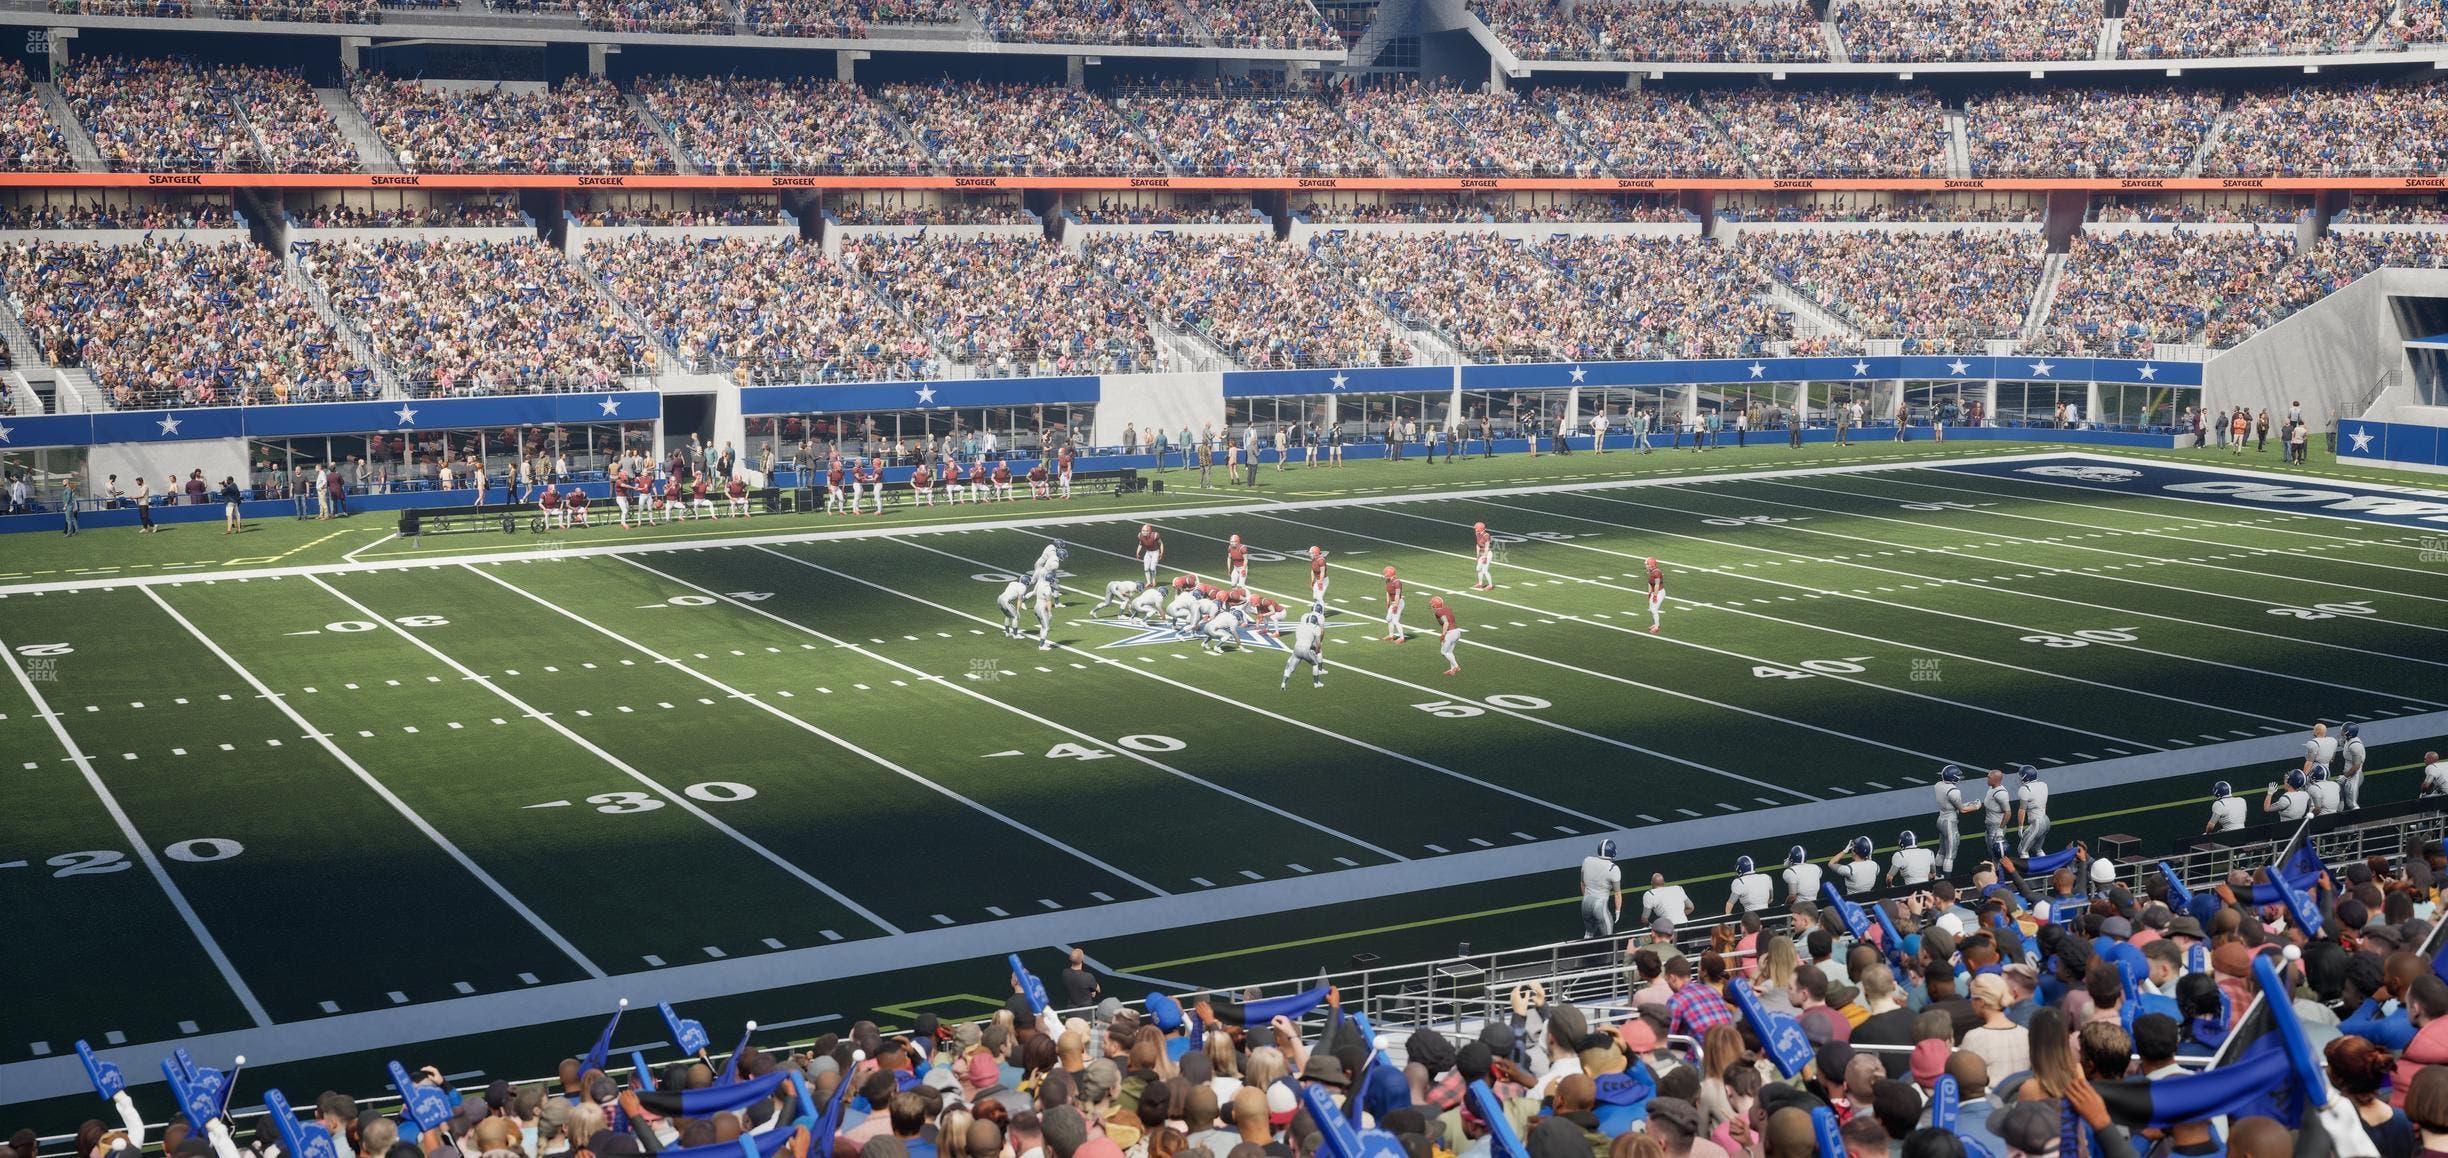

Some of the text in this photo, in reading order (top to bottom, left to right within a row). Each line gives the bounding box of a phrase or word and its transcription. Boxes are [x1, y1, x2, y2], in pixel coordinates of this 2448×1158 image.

[148, 175, 202, 184] SEATGEEK
[371, 176, 420, 185] SEATGEEK
[578, 177, 624, 185] SEATGEEK
[772, 177, 815, 186] SEATGEEK
[955, 178, 997, 186] SEATGEEK
[1130, 179, 1170, 187] SEATGEEK
[1298, 179, 1336, 187] SEATGEEK
[1618, 180, 1654, 188] SEATGEEK
[2405, 179, 2446, 187] SEATGEEK
[1752, 657, 1867, 681] 40
[1411, 693, 1552, 718] 50
[1044, 733, 1187, 761] 40
[585, 781, 758, 814] 30
[45, 837, 246, 878] 20
